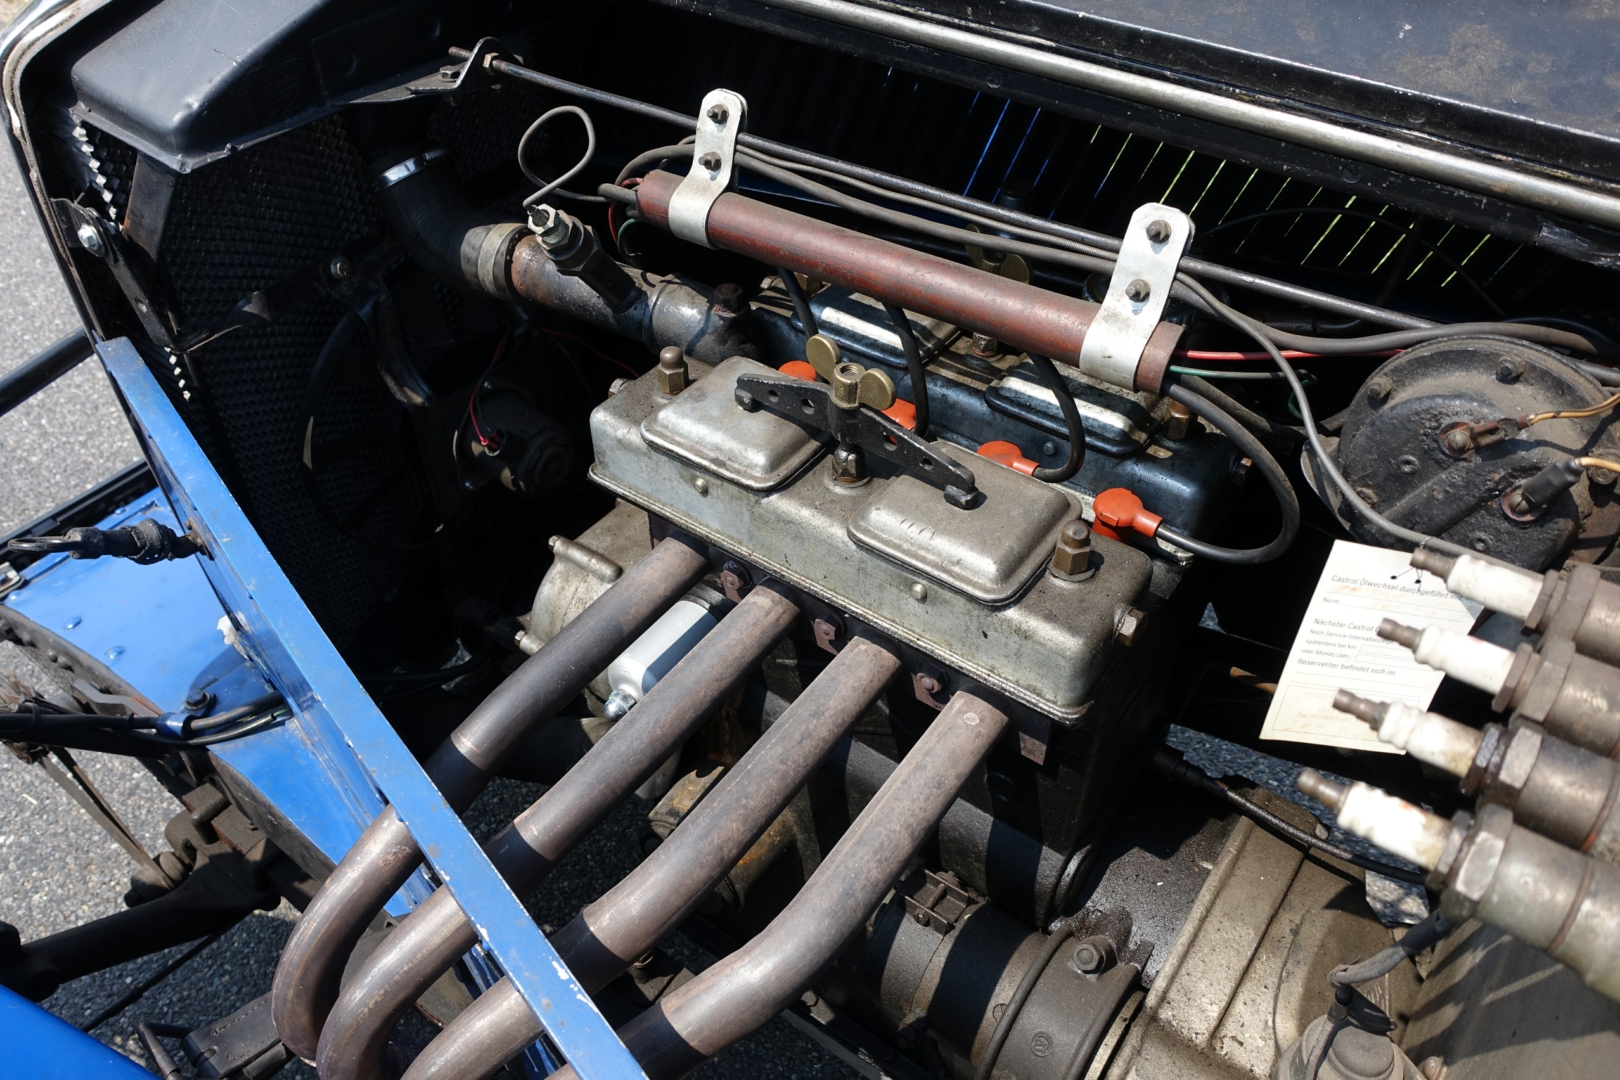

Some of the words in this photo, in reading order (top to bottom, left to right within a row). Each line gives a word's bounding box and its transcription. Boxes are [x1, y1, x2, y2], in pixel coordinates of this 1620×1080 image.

[1331, 574, 1359, 585] Castrol
[1359, 577, 1399, 591] Ölwechsel
[1399, 583, 1449, 599] durchgeführt
[1309, 628, 1325, 637] Nach
[1313, 618, 1347, 629] Nächster
[1347, 622, 1375, 633] Castrol
[1297, 658, 1340, 669] Reserveliter
[1340, 663, 1370, 673] befindet
[1370, 667, 1386, 675] sich
